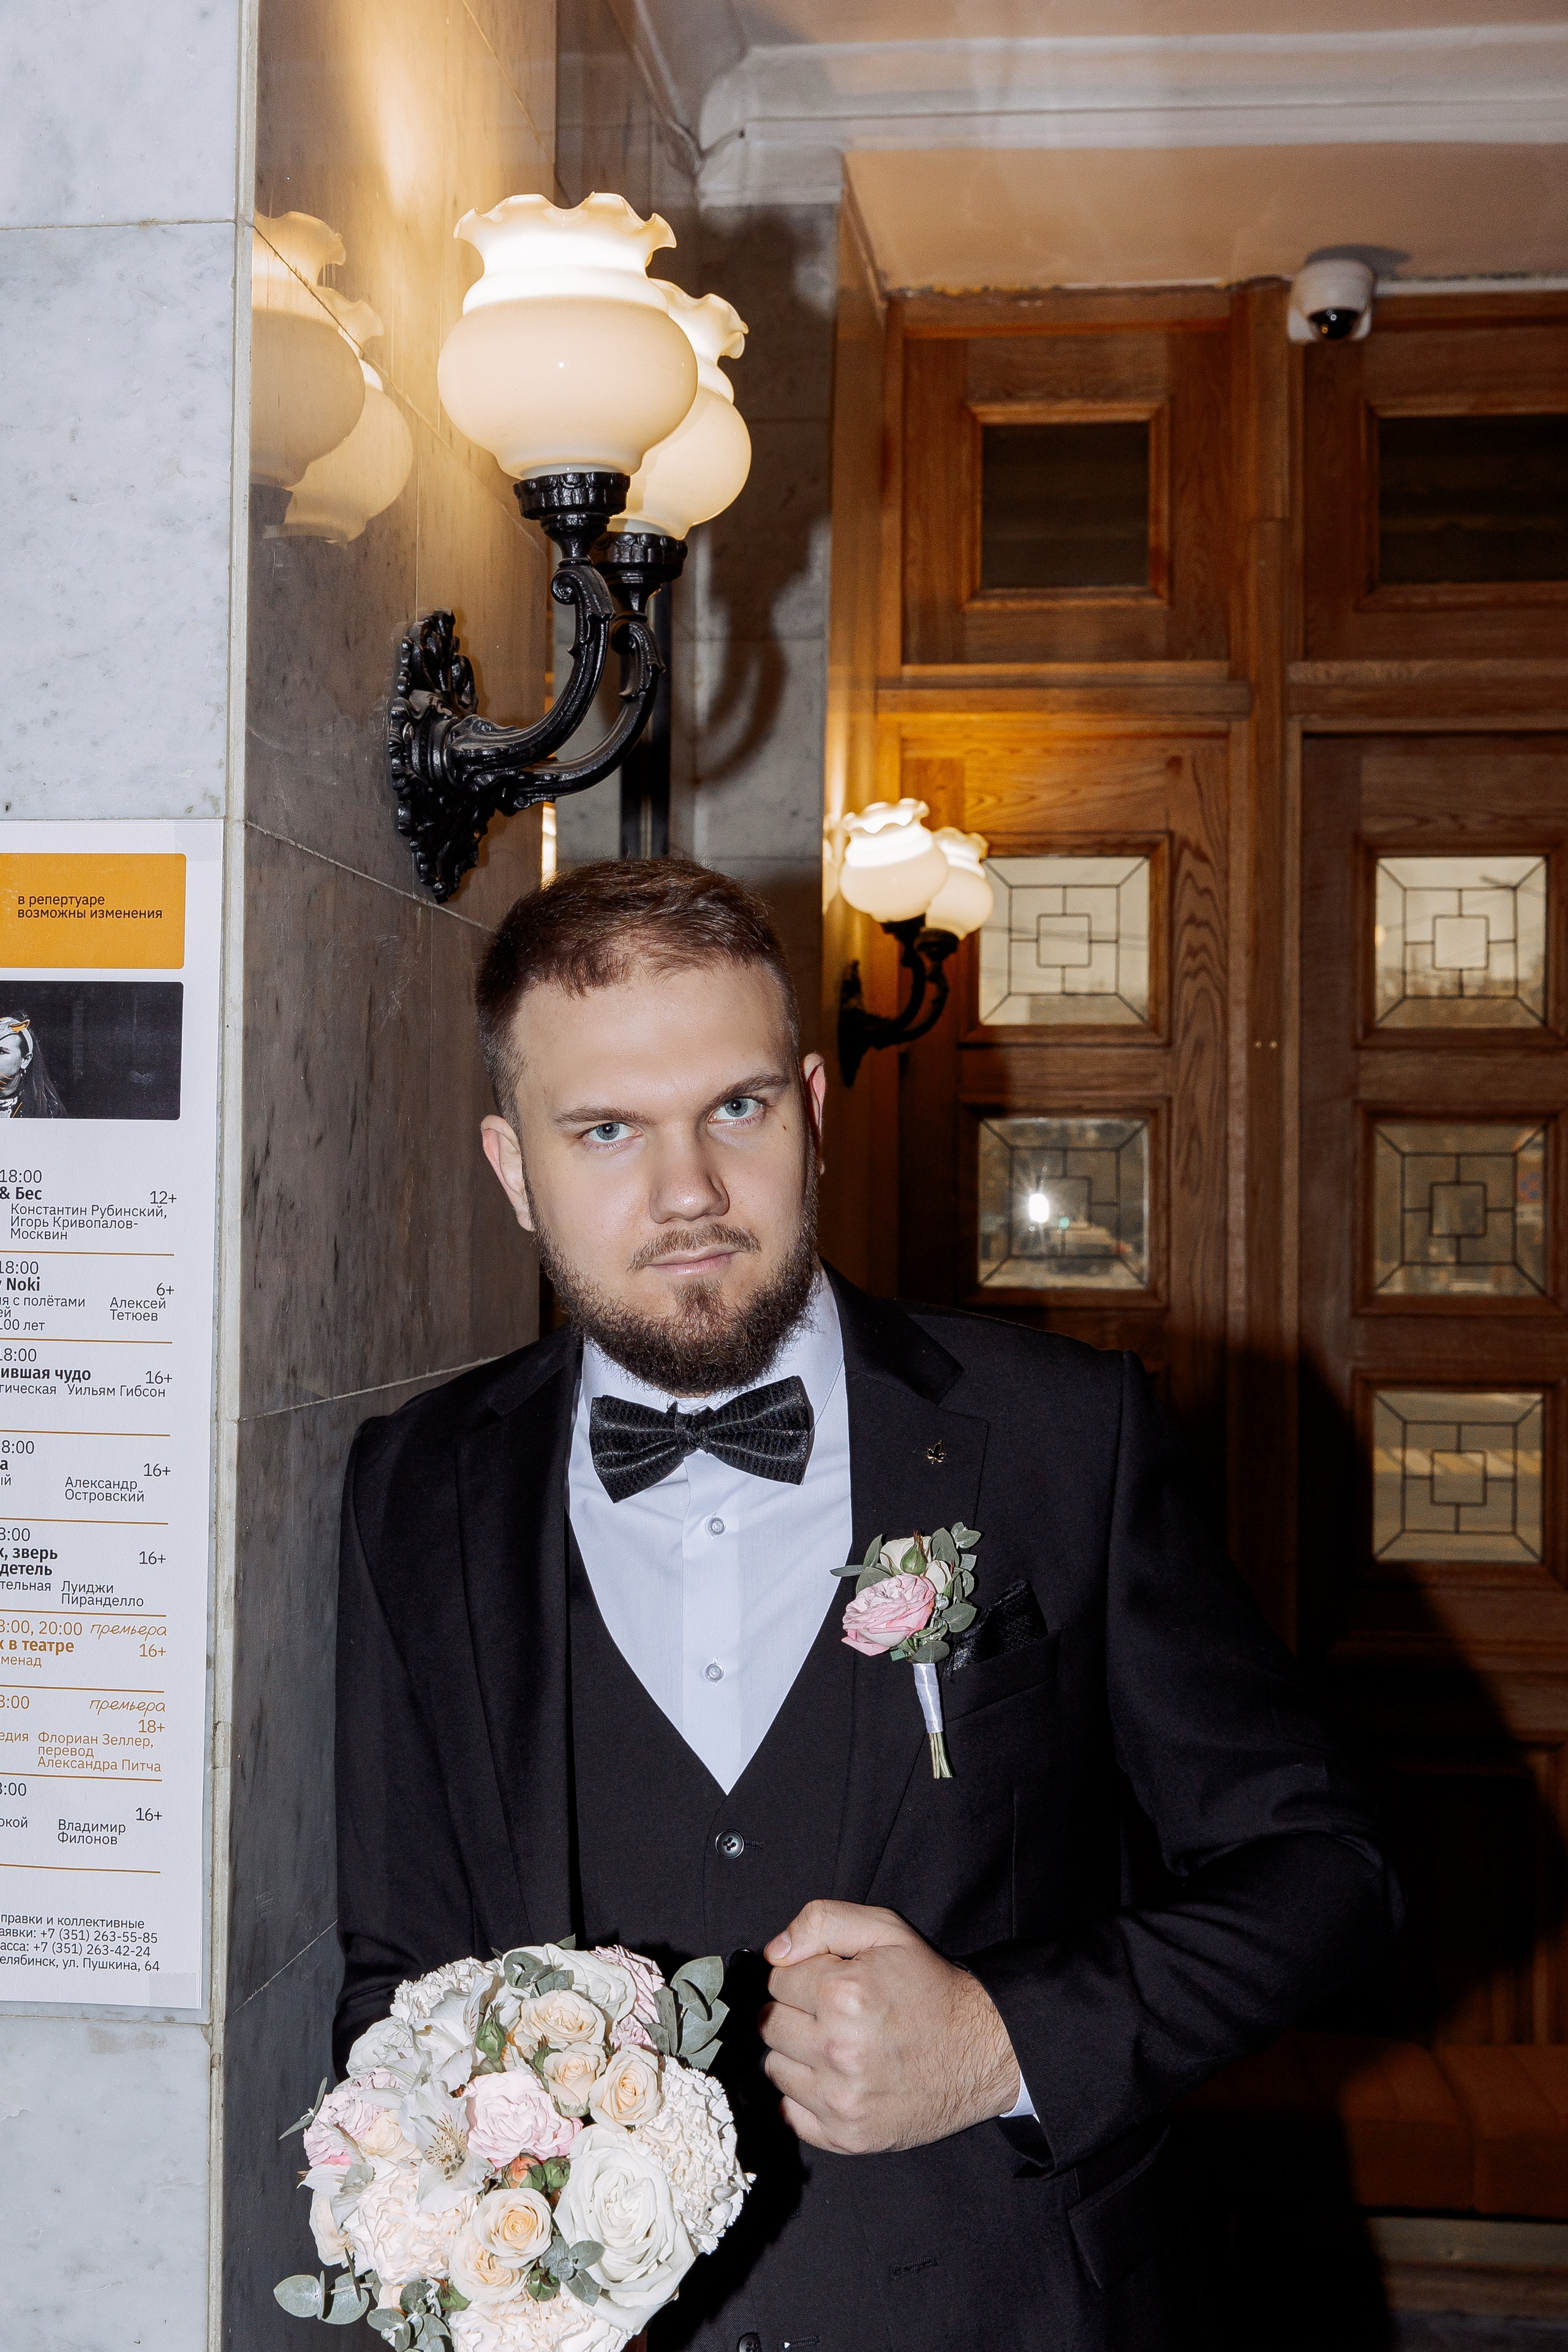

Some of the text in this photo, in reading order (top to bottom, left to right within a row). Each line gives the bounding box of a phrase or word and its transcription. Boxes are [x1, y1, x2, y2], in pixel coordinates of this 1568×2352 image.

[18, 896, 105, 908] в репертуаре
[18, 909, 162, 919] возможны изменения
[0, 1169, 42, 1183] 18:00
[16, 1186, 42, 1200] Бес
[150, 1191, 177, 1204] 12+
[11, 1203, 167, 1219] Константин Рубинский,
[11, 1215, 138, 1231] Игорь Кривопалов-
[10, 1227, 67, 1240] Москвин
[7, 1276, 40, 1291] Noki
[156, 1283, 175, 1296] 6+
[13, 1297, 20, 1306] с
[24, 1295, 85, 1307] полётами
[110, 1297, 165, 1309] Алексей
[110, 1309, 158, 1321] Тетюев
[23, 1322, 45, 1331] лет
[1, 1368, 91, 1384] ившая чудо
[145, 1371, 173, 1384] 16+
[0, 1384, 56, 1395] гическая
[67, 1384, 165, 1397] Уильям Гибсон
[143, 1463, 171, 1477] 16+
[65, 1476, 137, 1492] Александр
[65, 1488, 144, 1504] Островский
[12, 1548, 58, 1562] зверь
[139, 1551, 166, 1565] 16+
[0, 1564, 52, 1577] детель
[0, 1581, 51, 1591] тельная
[61, 1581, 113, 1595] Луиджи
[62, 1593, 144, 1608] Пиранделло
[39, 1621, 82, 1635] 20:00
[90, 1624, 167, 1642] премьера
[9, 1640, 17, 1650] в
[21, 1640, 74, 1656] театре
[139, 1644, 166, 1657] 16+
[1, 1656, 42, 1668] менад
[89, 1700, 165, 1717] премьера
[138, 1719, 165, 1733] 18+
[0, 1732, 28, 1743] едия
[38, 1731, 153, 1749] Флориан Зеллер,
[38, 1746, 94, 1758] перевод
[37, 1756, 161, 1773] Александра Питча
[135, 1807, 162, 1822] 16+
[58, 1819, 126, 1836] Владимир
[58, 1831, 118, 1845] Филонов
[1, 1914, 145, 1929] правки и коллективные
[0, 1928, 157, 1943] аявки: +7 (351) 263-55-85
[0, 1942, 151, 1957] асса: +7 (351) 263-42-24
[0, 1954, 160, 1972] елябинск, ул. Пушкина, 64
